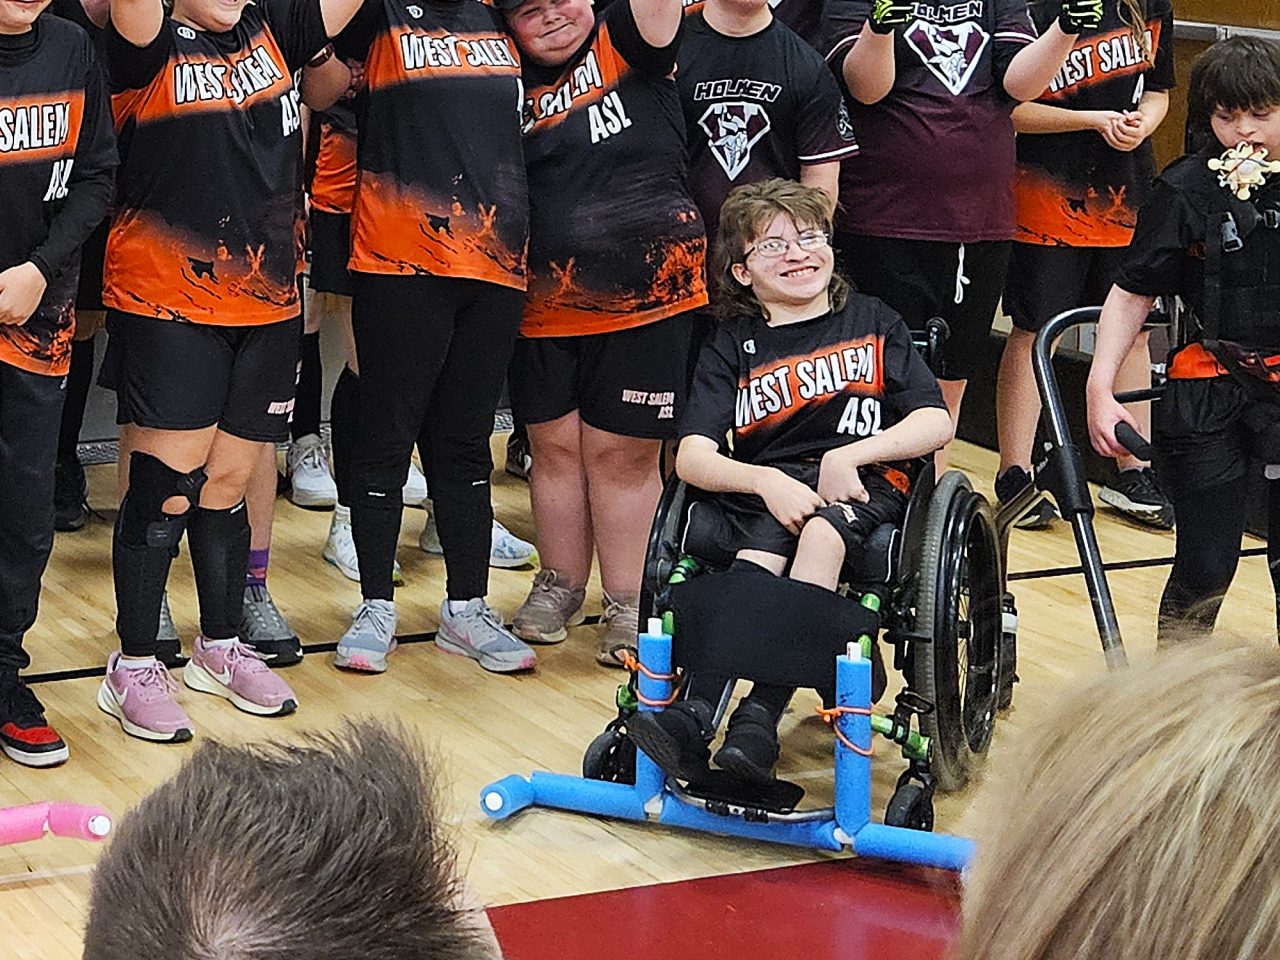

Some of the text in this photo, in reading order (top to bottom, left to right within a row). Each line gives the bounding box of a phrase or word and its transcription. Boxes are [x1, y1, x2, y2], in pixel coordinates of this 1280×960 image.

[401, 33, 462, 70] WEST
[174, 61, 228, 105] WEST
[693, 78, 782, 103] HOLMEN
[587, 90, 633, 145] ASL
[621, 389, 675, 406] WEST SALEM
[735, 343, 875, 428] WEST SALEM
[836, 396, 884, 437] ASL
